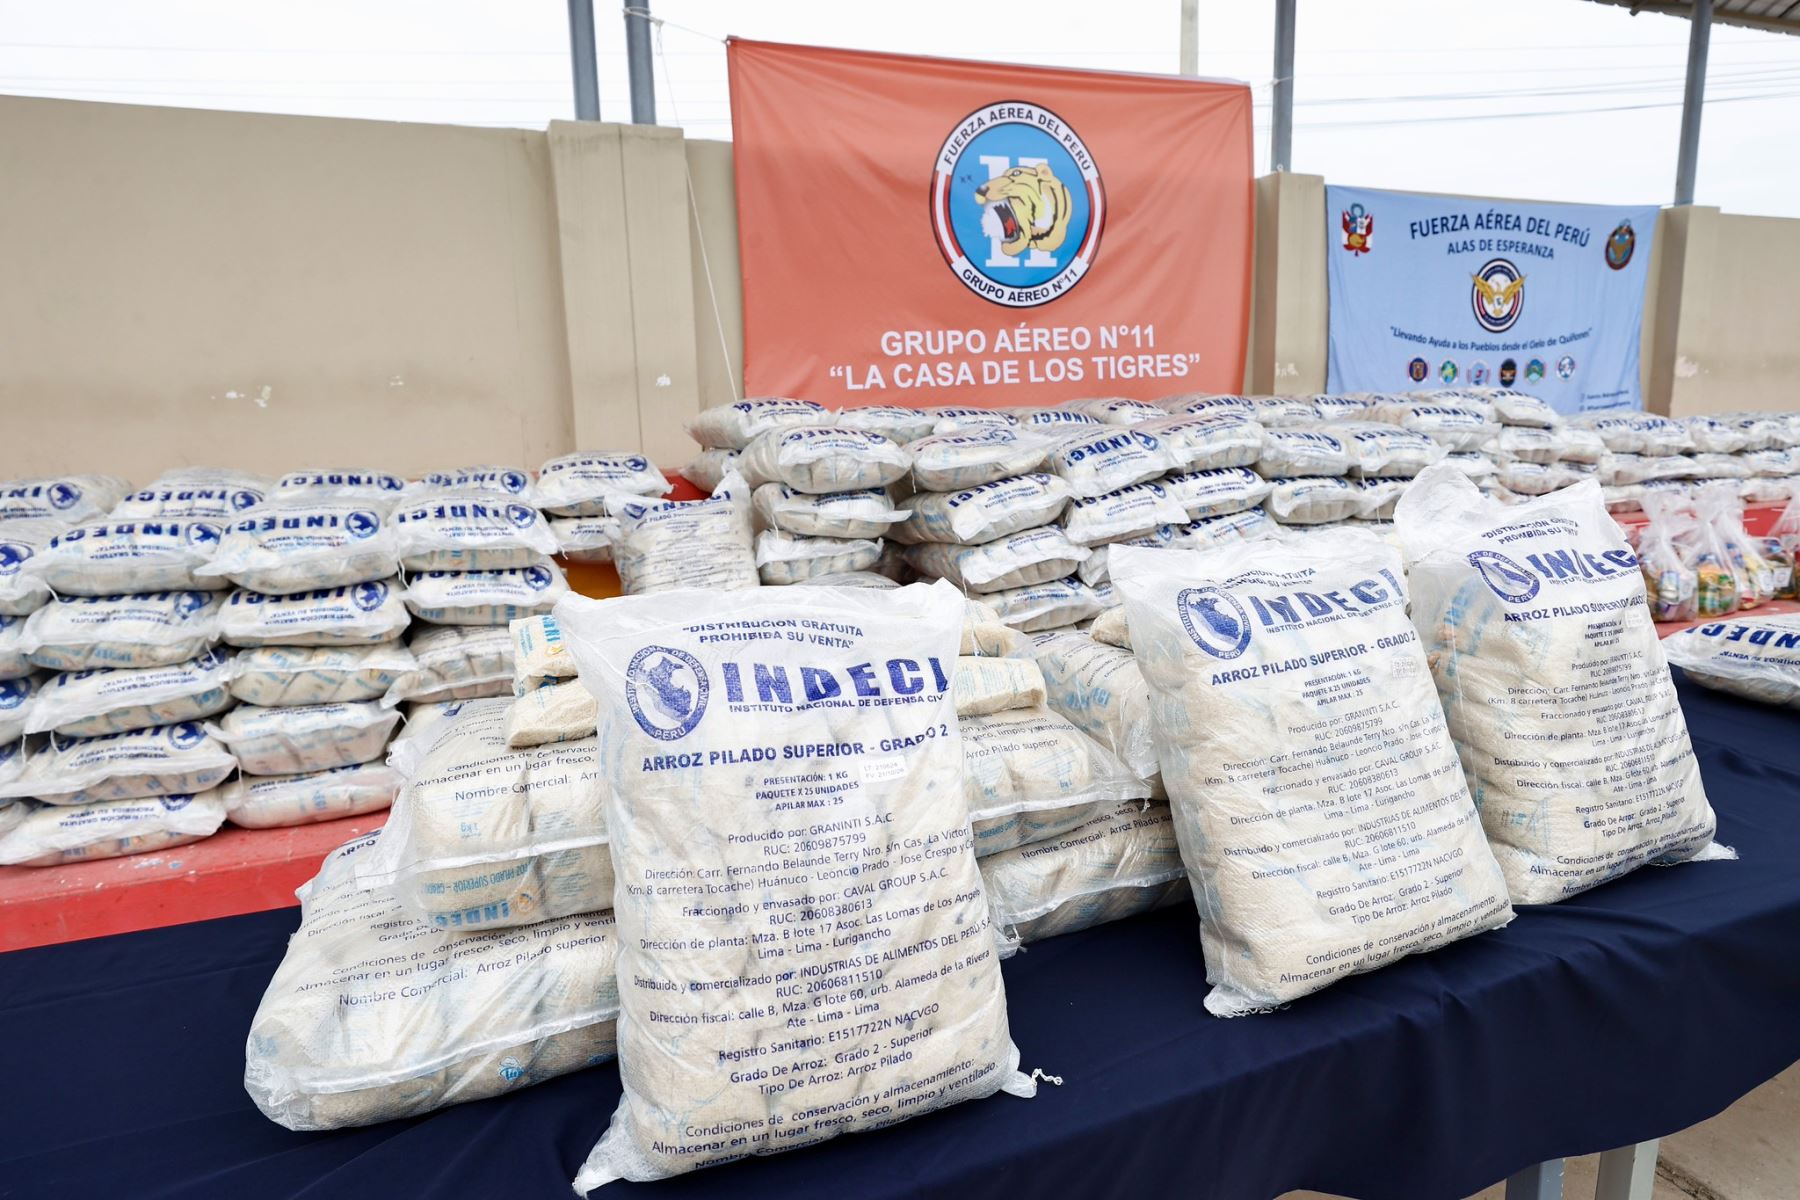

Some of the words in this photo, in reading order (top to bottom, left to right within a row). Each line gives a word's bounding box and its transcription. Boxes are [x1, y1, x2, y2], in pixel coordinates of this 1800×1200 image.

[944, 117, 986, 165] FUERZA
[989, 106, 1034, 123] AÉREA
[1038, 114, 1065, 136] DEL
[1063, 134, 1091, 171] PERÚ
[1410, 213, 1470, 239] FUERZA
[1474, 208, 1522, 231] AÉREA
[1526, 216, 1551, 236] DEL
[1554, 222, 1591, 247] PERÚ
[1447, 240, 1476, 255] ALAS
[1479, 239, 1493, 251] DE
[1496, 239, 1555, 259] ESPERANZA
[962, 269, 1004, 299] GRUPO
[1007, 287, 1050, 302] AÉREO
[880, 330, 987, 356] GRUPO
[993, 322, 1092, 353] AÉREO
[1428, 336, 1451, 348] Ayuda
[893, 361, 976, 388] CASA
[982, 360, 1019, 384] DE
[1028, 357, 1084, 383] LOS
[1092, 352, 1201, 380] TIGRES”
[124, 490, 228, 502] INDECI
[281, 475, 373, 487] INDECI
[225, 516, 338, 535] INDECI
[398, 504, 500, 523] INDECI
[51, 524, 179, 548] INDECI
[1248, 568, 1403, 626] INDECI
[1503, 608, 1551, 622] ARROZ
[1553, 602, 1590, 617] PILADO
[700, 631, 782, 643] PROHIBIDA
[787, 631, 804, 642] SU
[802, 620, 863, 637] GRATUITA
[1211, 667, 1260, 686] ARROZ
[1262, 657, 1308, 676] PILADO
[1310, 643, 1368, 666] SUPERIOR
[1377, 632, 1410, 649] GRADO
[722, 657, 949, 703] INDECI
[729, 704, 793, 713] INSTITUTO
[797, 700, 855, 711] NACIONAL
[859, 699, 870, 707] DE
[874, 696, 925, 706] DEFENSA
[642, 752, 703, 772] ARROZ
[710, 747, 777, 765] PILADO
[783, 742, 864, 760] SUPERIOR
[880, 726, 936, 751] GRADO
[940, 724, 948, 736] 2
[654, 727, 686, 740] PERU
[966, 749, 989, 759] Arroz
[455, 786, 508, 802] Nombre
[511, 775, 571, 794] Comercial:
[755, 787, 796, 800] PAQUETE
[805, 786, 814, 796] 25
[814, 781, 859, 795] UNIDADES
[763, 773, 827, 787] PRESENTACIÓN:
[836, 770, 848, 780] KG
[775, 800, 806, 811] APILAR
[807, 798, 826, 809] MAX
[833, 796, 844, 806] 25
[728, 829, 784, 844] Producido
[788, 829, 806, 840] por:
[809, 819, 861, 835] GRANINTI
[865, 812, 895, 827] S.A.C.
[1022, 845, 1058, 859] Nombre
[1059, 831, 1106, 850] Comercial:
[1109, 822, 1132, 836] Arroz
[1133, 815, 1159, 829] Pilado
[764, 843, 790, 856] RUC:
[794, 833, 866, 852] 20609875799
[657, 884, 703, 895] carretera
[705, 878, 754, 895] Tocache)
[758, 874, 808, 889] Huánuco
[817, 866, 859, 881] Leoncio
[862, 858, 889, 873] Prado
[900, 853, 922, 865] Jose
[925, 845, 957, 861] Crespo
[697, 868, 723, 879] Carr.
[727, 861, 780, 876] Fernando
[783, 853, 830, 869] Belaunde
[834, 847, 859, 863] Terry
[863, 845, 881, 857] Nro.
[683, 903, 749, 917] Fraccionado
[762, 894, 815, 910] envasado
[819, 892, 840, 906] por:
[844, 882, 876, 898] CAVAL
[878, 874, 916, 891] GROUP
[800, 899, 872, 921] 20608380613
[640, 938, 686, 950] Dirección
[708, 935, 748, 951] planta:
[752, 933, 779, 944] Mza.
[836, 919, 862, 931] Asoc.
[886, 907, 920, 922] Lomas
[758, 947, 784, 959] Lima
[833, 927, 891, 947] Lurigancho
[476, 958, 512, 976] Arroz
[556, 934, 607, 954] superior
[634, 975, 677, 991] Distribuido
[690, 974, 772, 991] comercializado
[800, 955, 862, 978] INDUSTRIAS
[882, 938, 938, 962] ALIMENTOS
[650, 1010, 698, 1024] Dirección
[702, 1010, 735, 1023] fiscal:
[894, 970, 938, 990] Alameda
[966, 950, 990, 967] Rivera
[776, 984, 803, 998] RUC:
[807, 968, 883, 993] 20606811510
[1279, 965, 1336, 984] Almacenar
[338, 989, 396, 1008] Nombre
[719, 1046, 767, 1062] Registro
[770, 1035, 825, 1053] Sanitario:
[828, 1020, 892, 1042] E1517722N
[895, 1003, 939, 1024] NACVGO
[817, 1011, 844, 1024] Lima
[730, 1068, 768, 1083] Grado
[792, 1057, 827, 1073] Arroz:
[834, 1048, 870, 1065] Grado
[890, 1026, 933, 1049] Superior
[758, 1084, 785, 1097] Tipo
[808, 1068, 843, 1086] Arroz:
[847, 1062, 877, 1077] Arroz
[880, 1050, 913, 1068] Pilado
[652, 1141, 726, 1155] Almacenar
[774, 1124, 810, 1140] lugar
[814, 1112, 857, 1130] fresco,
[862, 1104, 893, 1119] seco,
[897, 1090, 935, 1110] limpio
[949, 1061, 998, 1091] ventilado.
[685, 1119, 764, 1137] Condiciones
[792, 1094, 870, 1122] conservación
[883, 1058, 975, 1099] almacenamiento:
